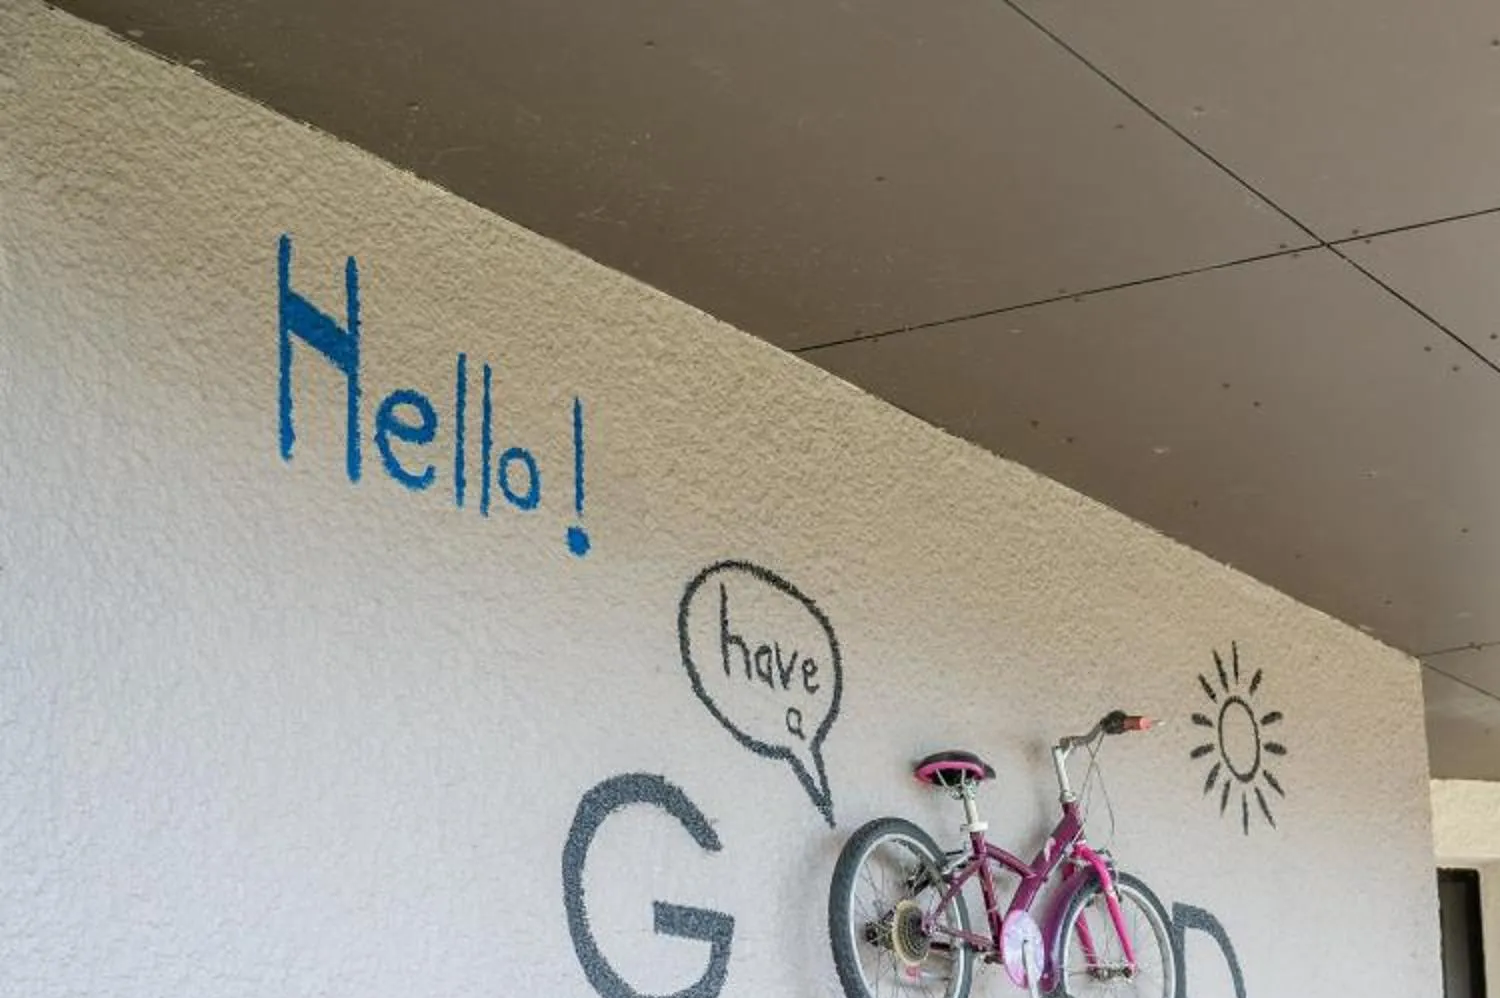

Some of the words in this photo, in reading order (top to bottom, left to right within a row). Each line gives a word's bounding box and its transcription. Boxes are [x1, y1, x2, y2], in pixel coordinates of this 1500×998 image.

[278, 233, 591, 557] Hello!
[719, 581, 820, 695] have
[786, 706, 806, 741] a
